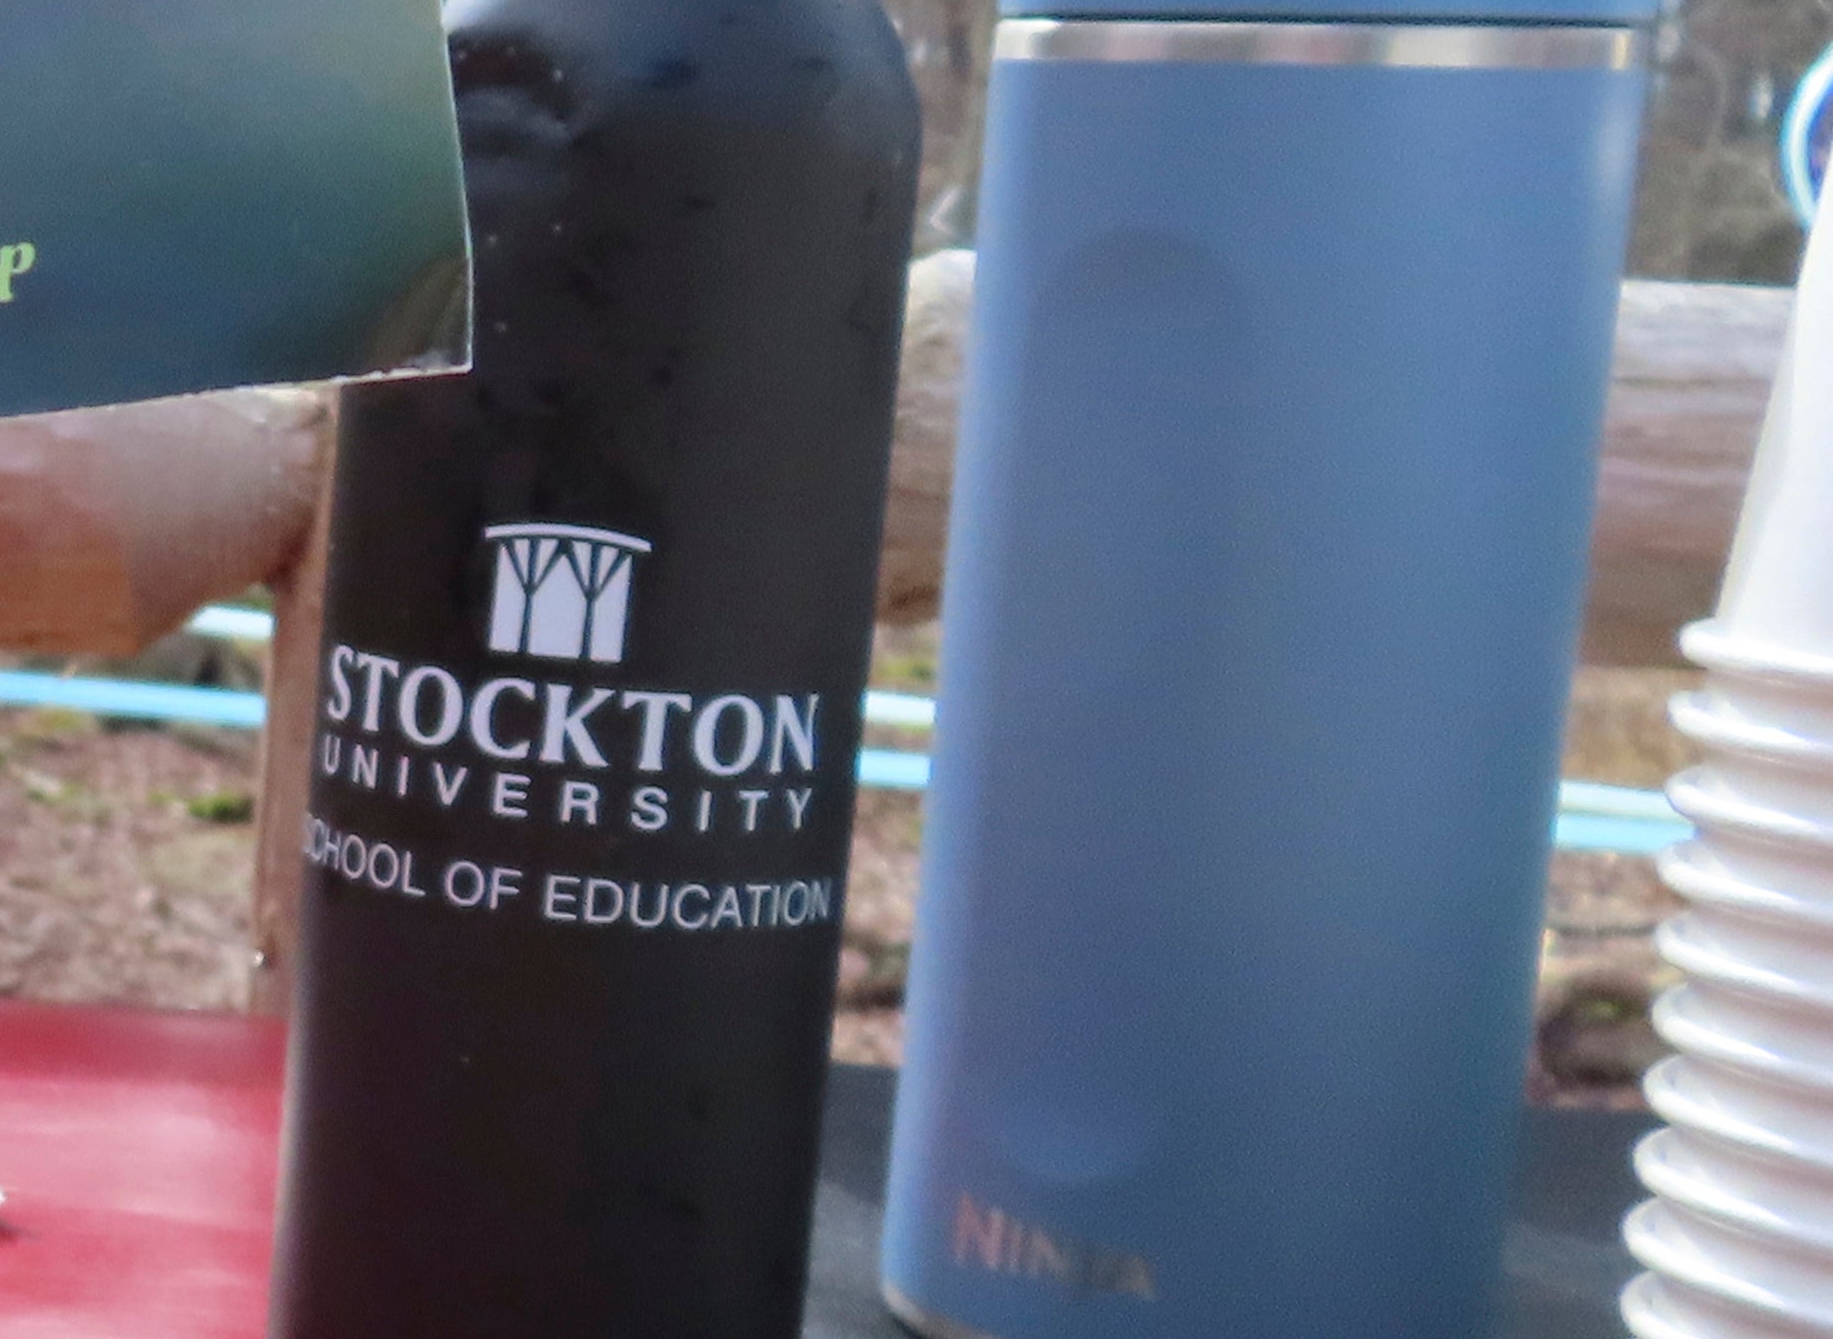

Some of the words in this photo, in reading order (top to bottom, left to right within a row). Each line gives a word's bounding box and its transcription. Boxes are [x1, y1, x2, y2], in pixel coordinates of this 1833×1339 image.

[327, 644, 819, 777] STOCKTON
[324, 736, 813, 832] UNIVERSITY
[443, 860, 522, 909] OF
[543, 874, 830, 928] EDUCATION
[953, 1191, 1157, 1300] NINA
